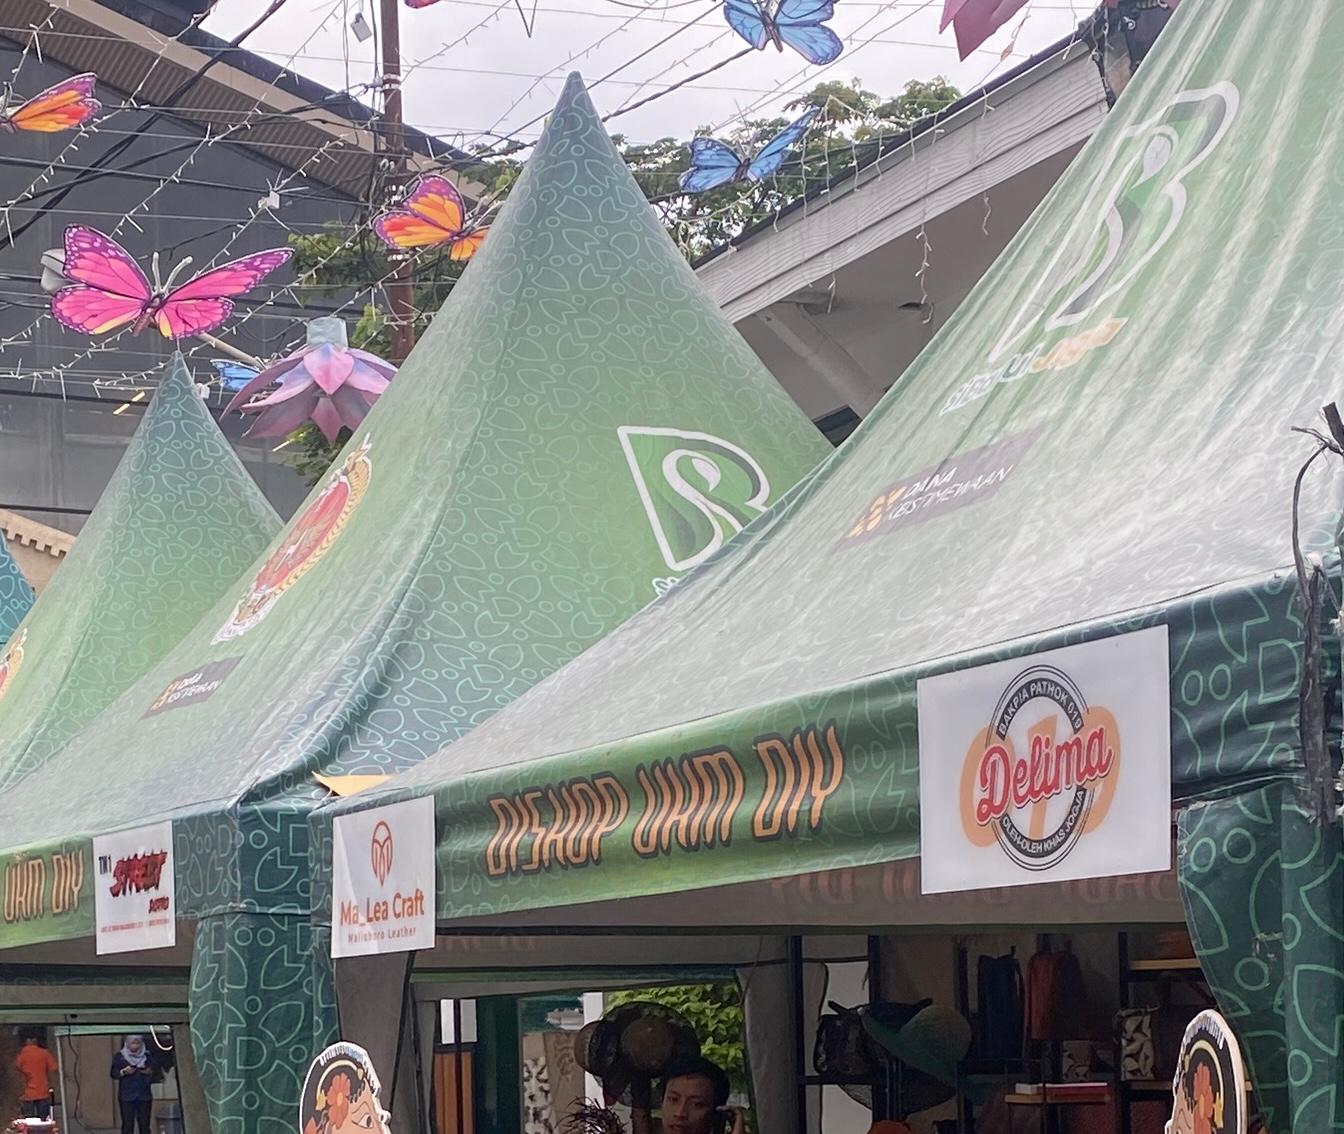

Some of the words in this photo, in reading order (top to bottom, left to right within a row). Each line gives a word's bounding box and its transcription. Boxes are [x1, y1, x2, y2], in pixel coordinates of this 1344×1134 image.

[999, 688, 1029, 735] BAKPIA
[1030, 680, 1068, 708] PATHOK
[487, 776, 629, 875] DISKOP
[632, 752, 744, 854] UKM
[752, 726, 844, 837] DIY
[976, 727, 1113, 824] Delima
[1044, 829, 1066, 852] KHAS
[1065, 790, 1085, 832] JOGJA
[4, 858, 44, 923] UKM
[52, 850, 84, 914] DIY
[393, 888, 424, 918] Craft
[388, 926, 417, 938] Leather
